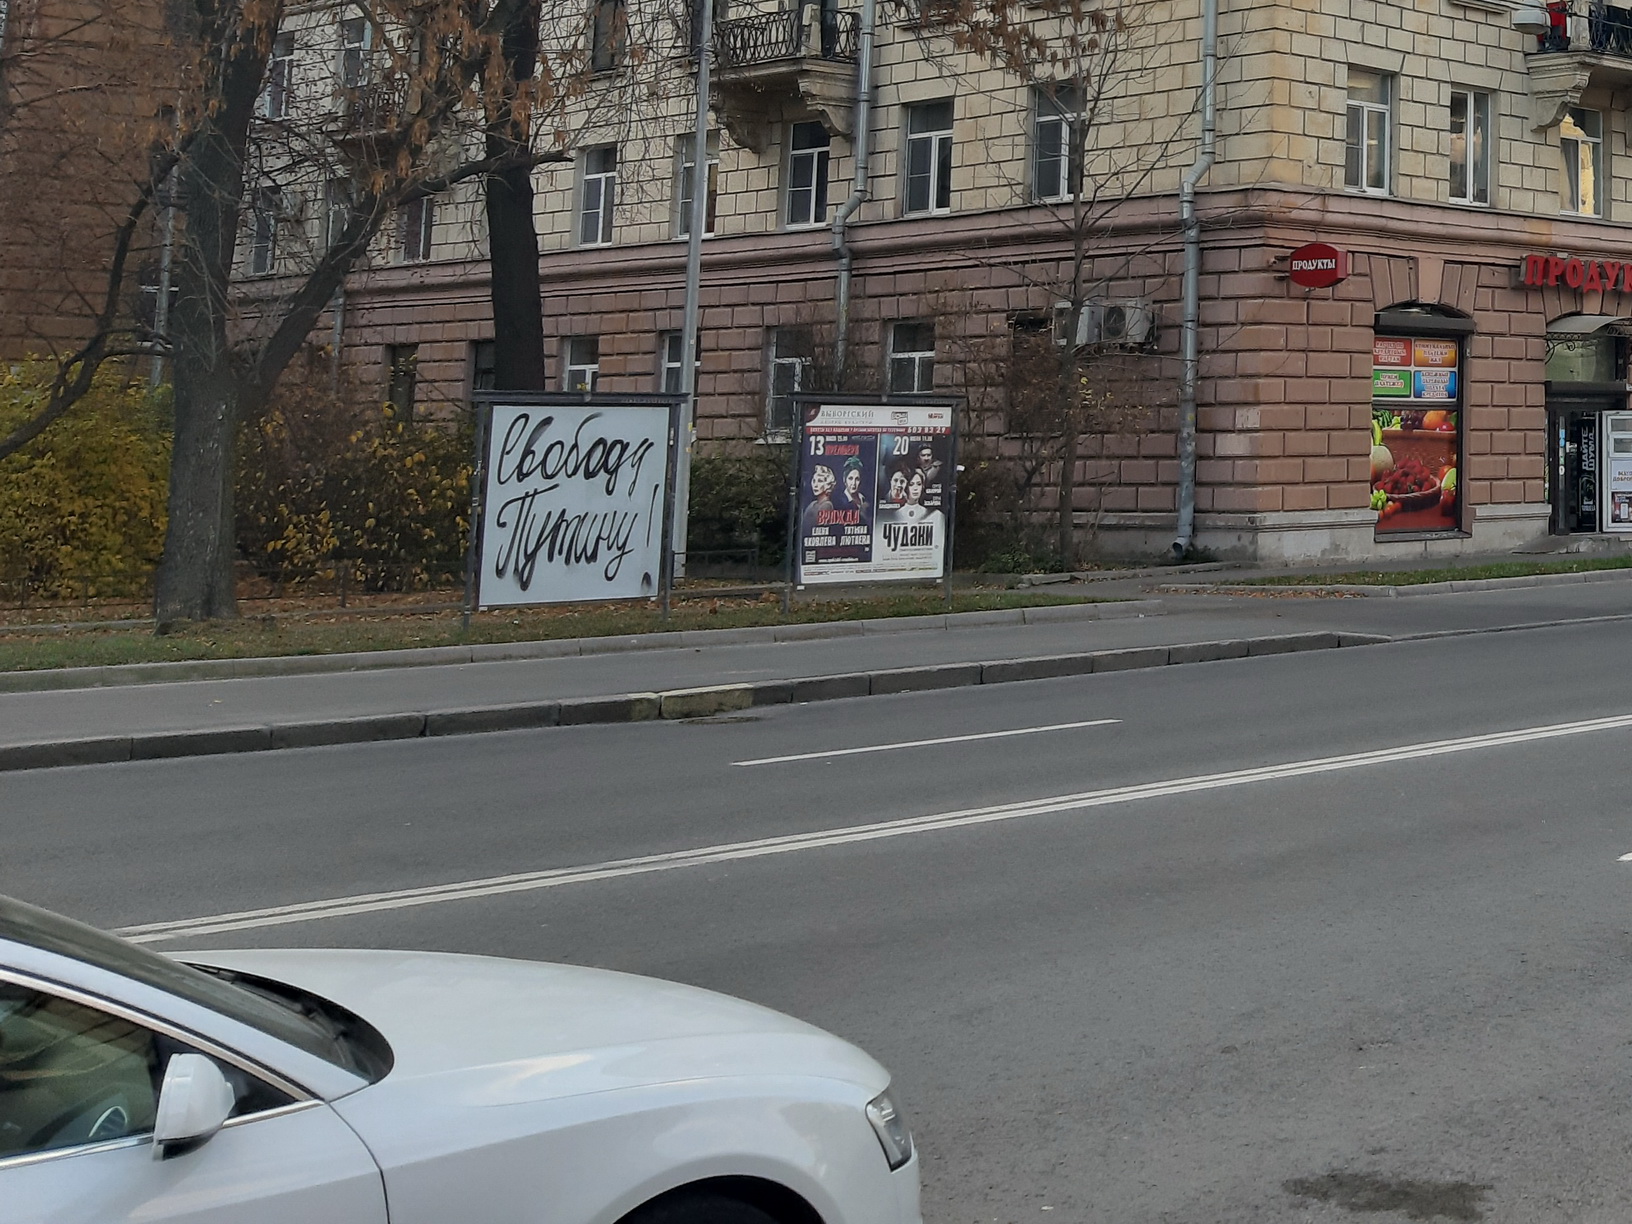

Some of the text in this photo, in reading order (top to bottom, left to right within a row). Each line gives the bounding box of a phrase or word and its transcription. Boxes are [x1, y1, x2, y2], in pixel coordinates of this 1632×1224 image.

[1292, 258, 1336, 271] ПРОДУКТЫ
[809, 435, 825, 456] 13
[893, 435, 910, 455] 20
[497, 411, 655, 501] Свободу
[817, 509, 861, 526] ВРАЖДА
